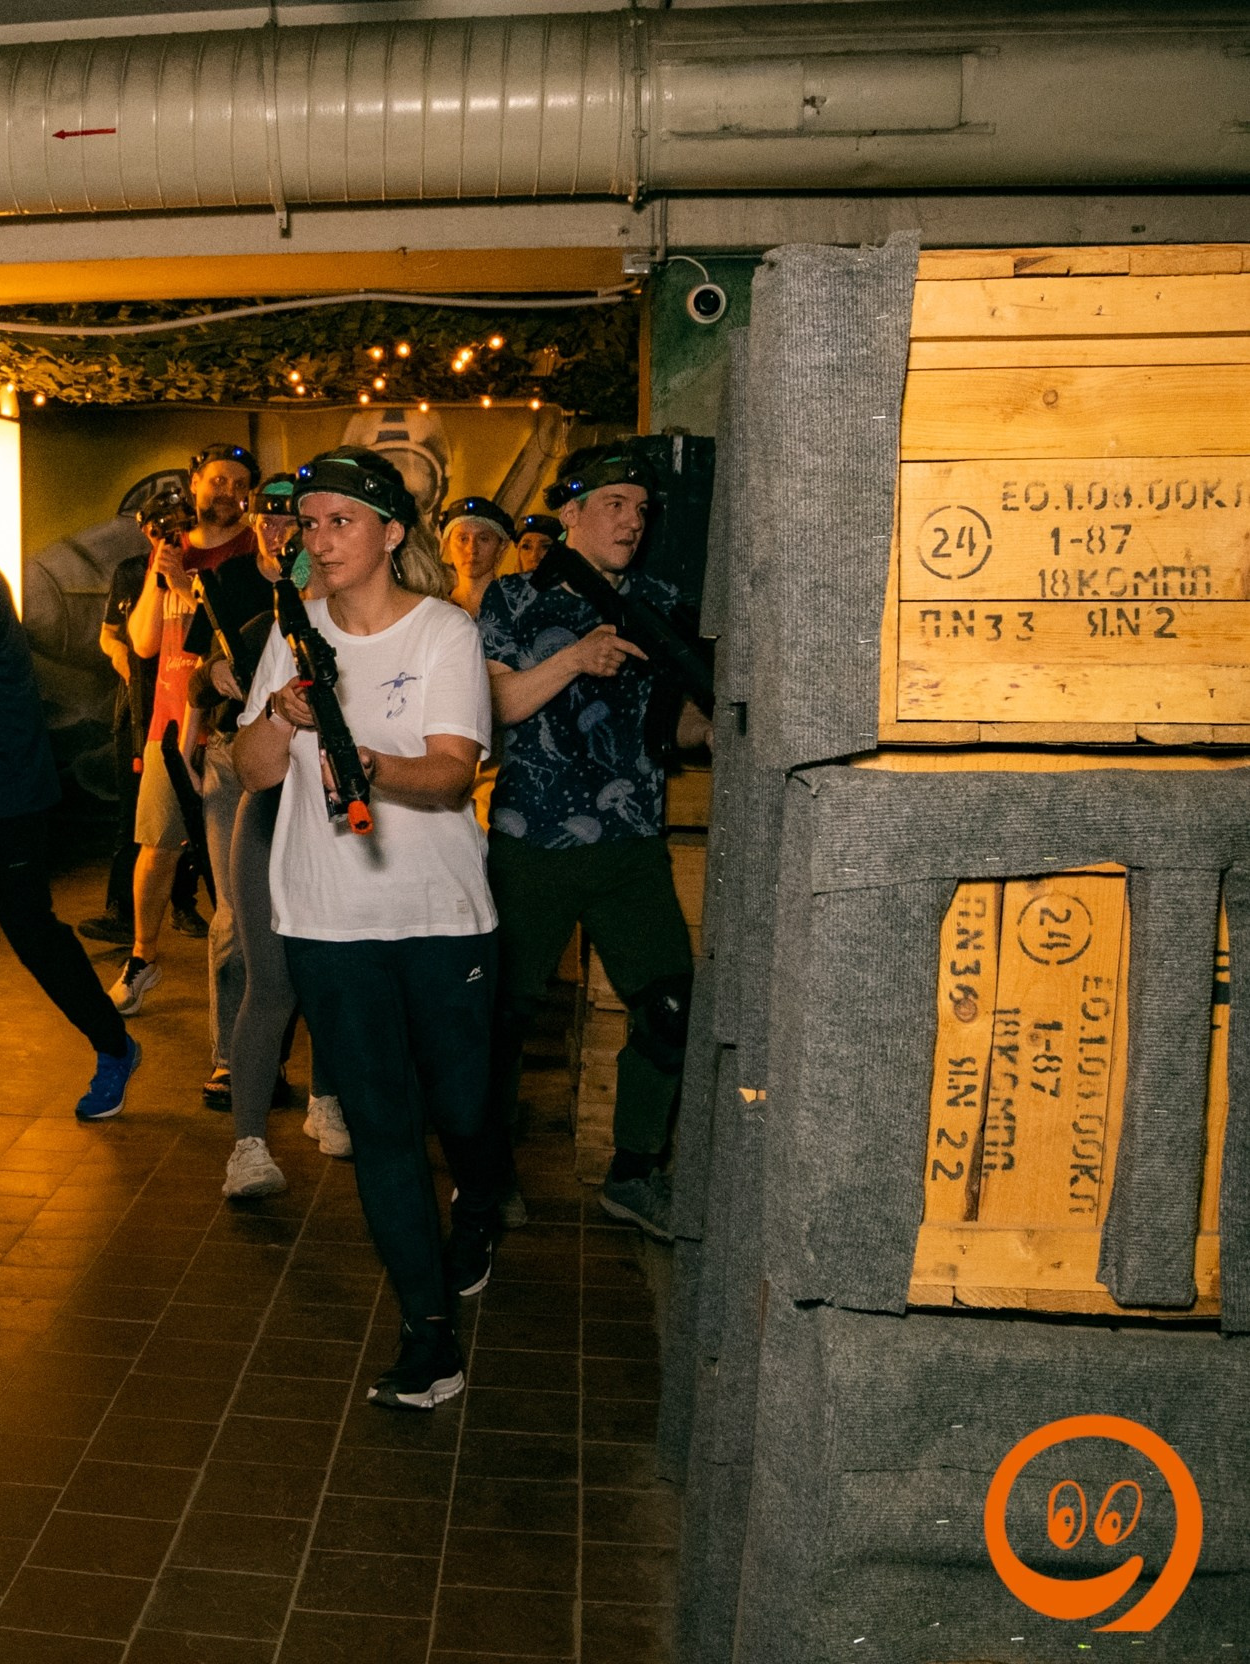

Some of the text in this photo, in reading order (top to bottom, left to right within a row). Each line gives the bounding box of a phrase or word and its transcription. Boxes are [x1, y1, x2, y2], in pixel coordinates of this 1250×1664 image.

[931, 525, 977, 558] 24
[1050, 523, 1133, 556] 1-87
[1039, 906, 1072, 950] 24
[1030, 1020, 1064, 1099] 1-87
